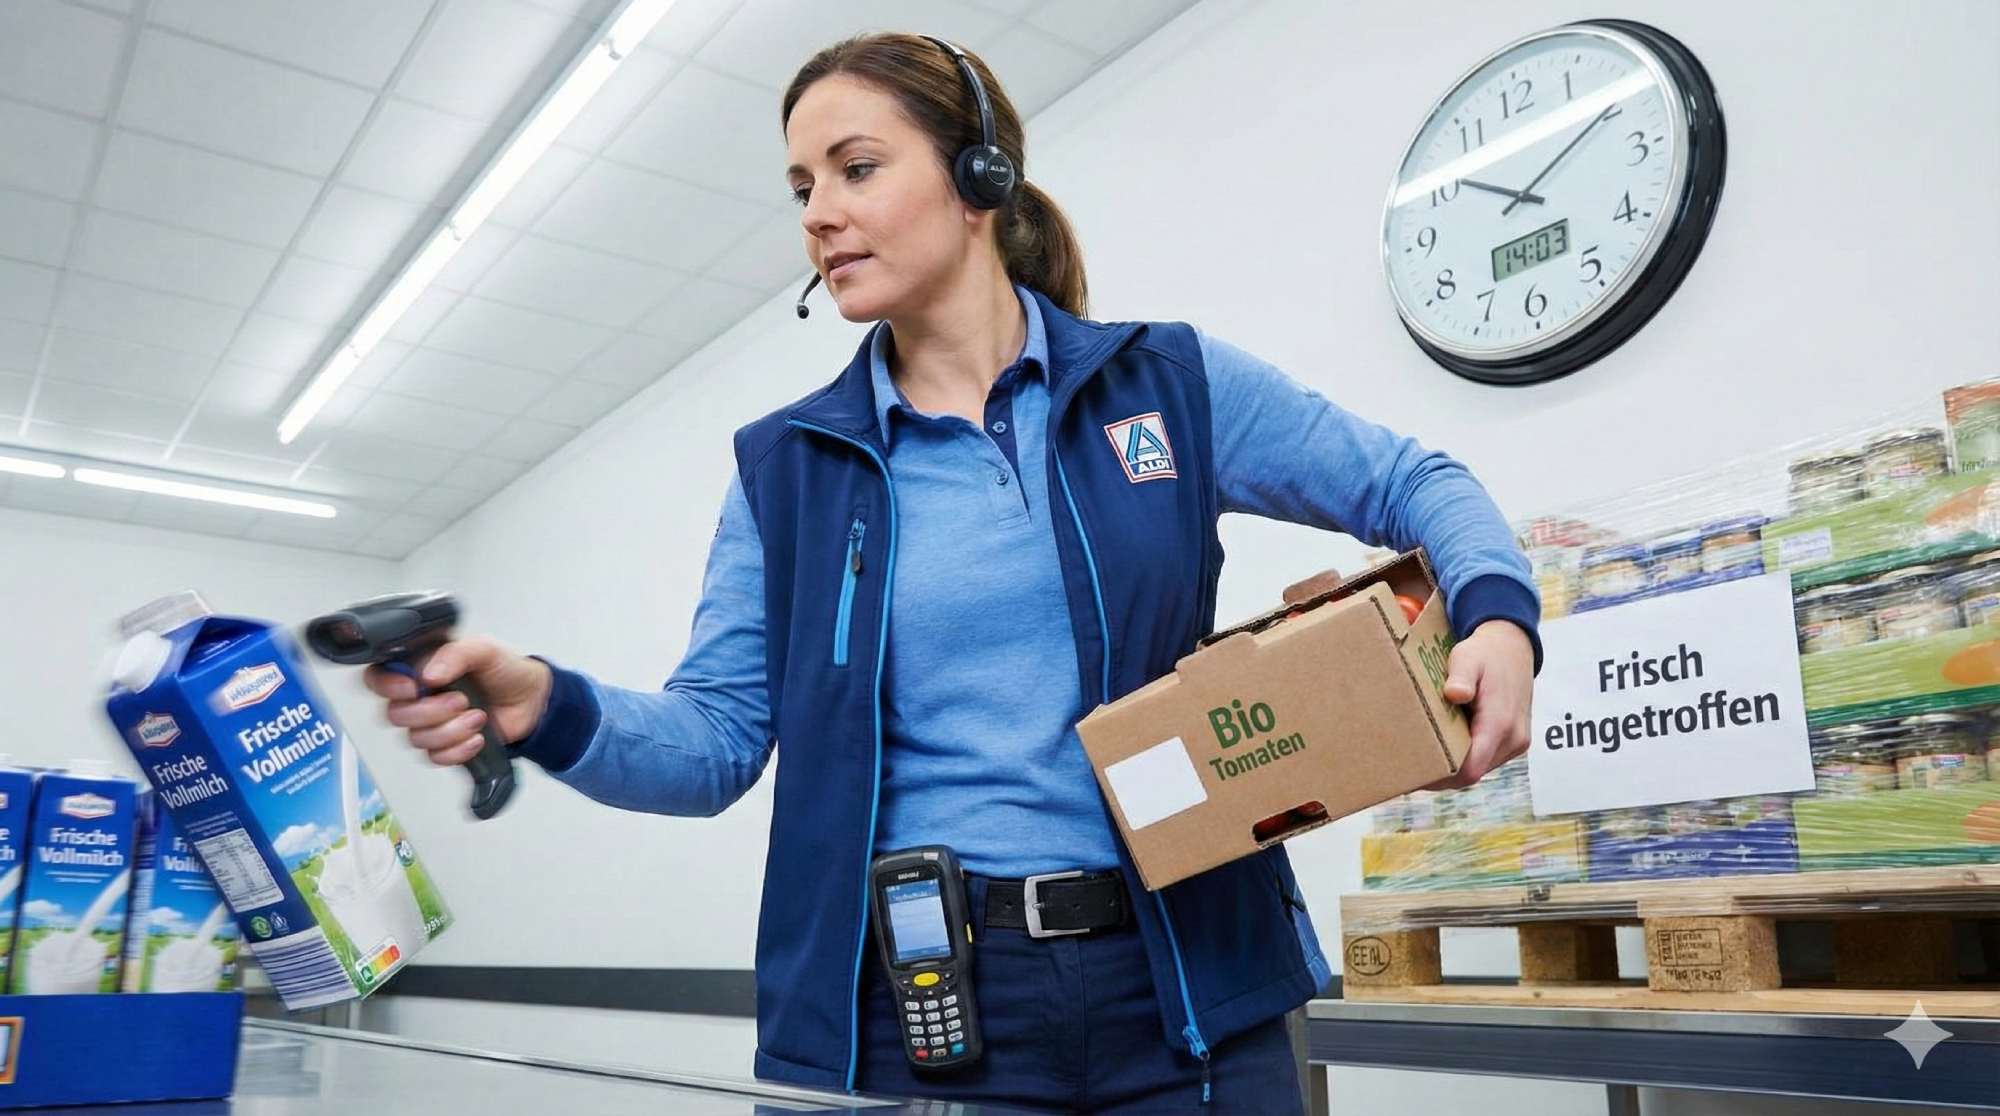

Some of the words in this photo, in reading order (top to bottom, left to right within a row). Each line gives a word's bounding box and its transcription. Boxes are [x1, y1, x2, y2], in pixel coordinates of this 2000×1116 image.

[1500, 79, 1535, 119] 12
[1562, 71, 1573, 101] 1
[1460, 117, 1484, 153] 11
[1625, 131, 1650, 166] 3
[1612, 190, 1638, 223] 4
[1416, 227, 1437, 259] 9
[1506, 225, 1567, 273] 14:03
[1580, 245, 1602, 283] 5
[1436, 269, 1456, 300] 8
[1524, 284, 1547, 318] 6
[1476, 289, 1496, 322] 7
[1138, 459, 1170, 473] ALDI
[1599, 643, 1704, 693] Frisch
[238, 703, 313, 754] Frische
[1208, 699, 1275, 749] Bio
[1545, 690, 1780, 753] eingetroffen
[241, 720, 336, 783] Vollmilch
[1209, 732, 1306, 781] Tomaten
[153, 755, 208, 785] Frische
[160, 773, 229, 810] Vollmilch
[50, 827, 119, 846] Frische
[38, 846, 124, 866] Vollmilch
